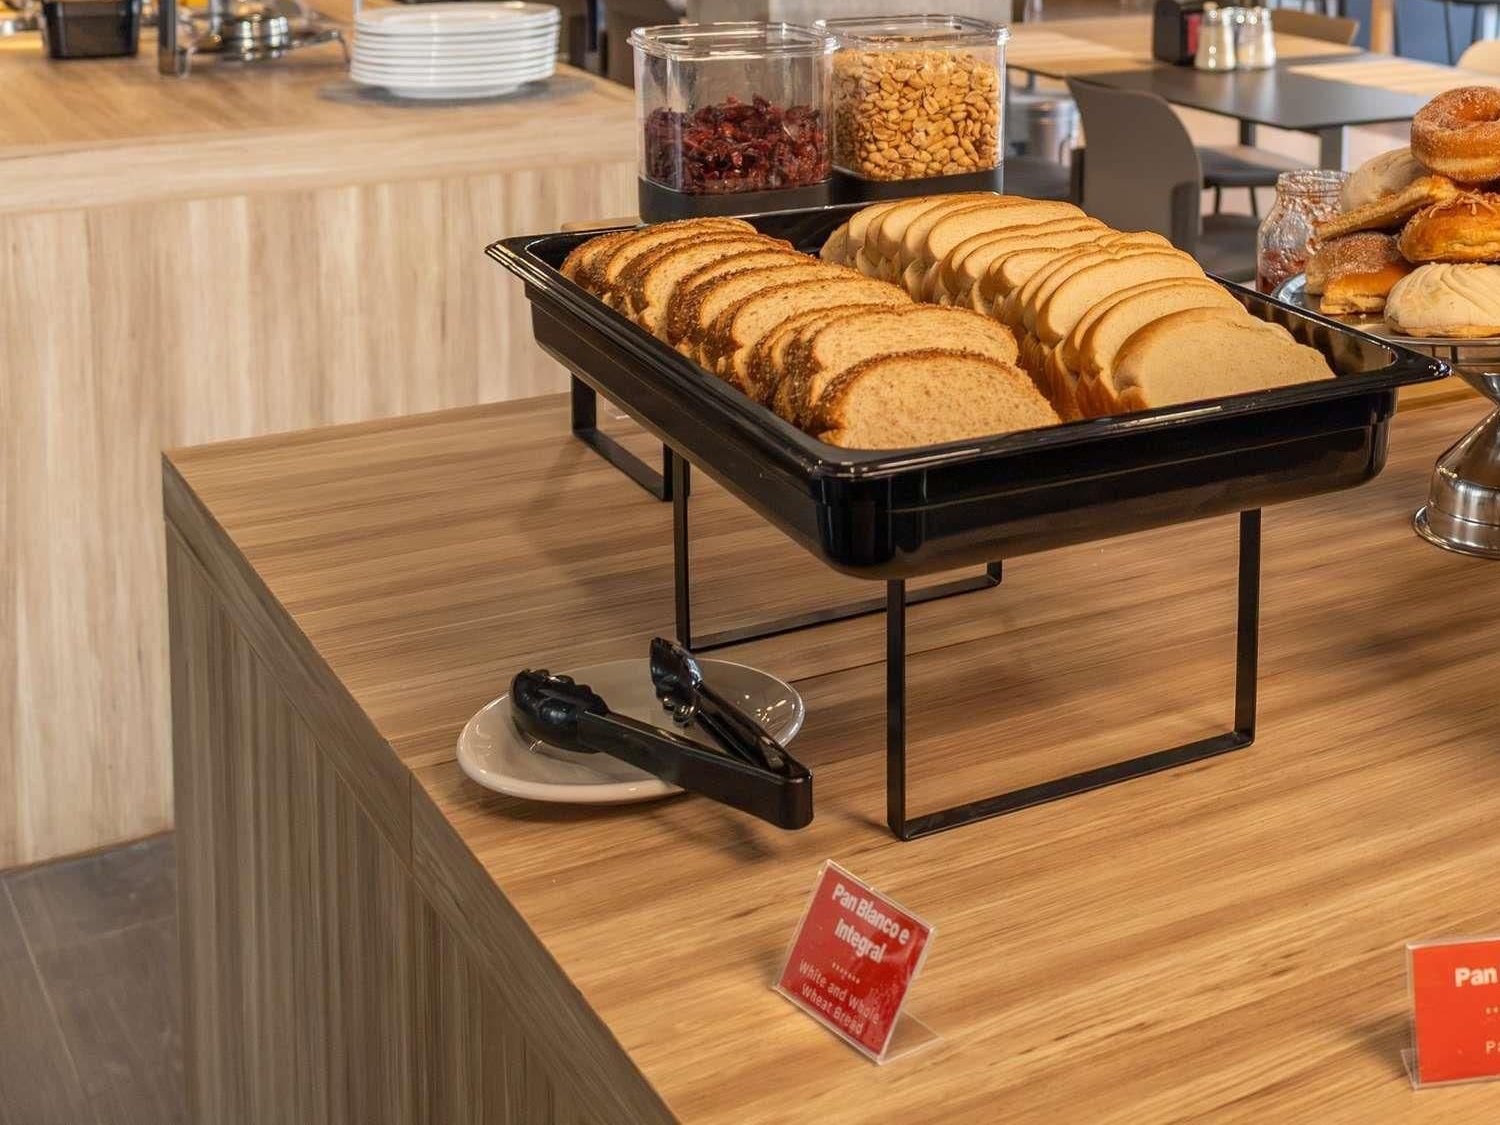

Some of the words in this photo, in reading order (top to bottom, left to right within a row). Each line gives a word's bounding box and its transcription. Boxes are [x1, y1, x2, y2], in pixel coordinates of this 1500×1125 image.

[832, 883, 856, 912] Pan
[856, 900, 899, 938] Blanco
[898, 928, 910, 945] e
[834, 918, 887, 963] Integral
[799, 960, 826, 987] White
[827, 981, 846, 1000] and
[849, 995, 880, 1024] Whole
[1455, 967, 1498, 987] Pan
[802, 983, 832, 1014] Wheat
[833, 1006, 864, 1034] Bread
